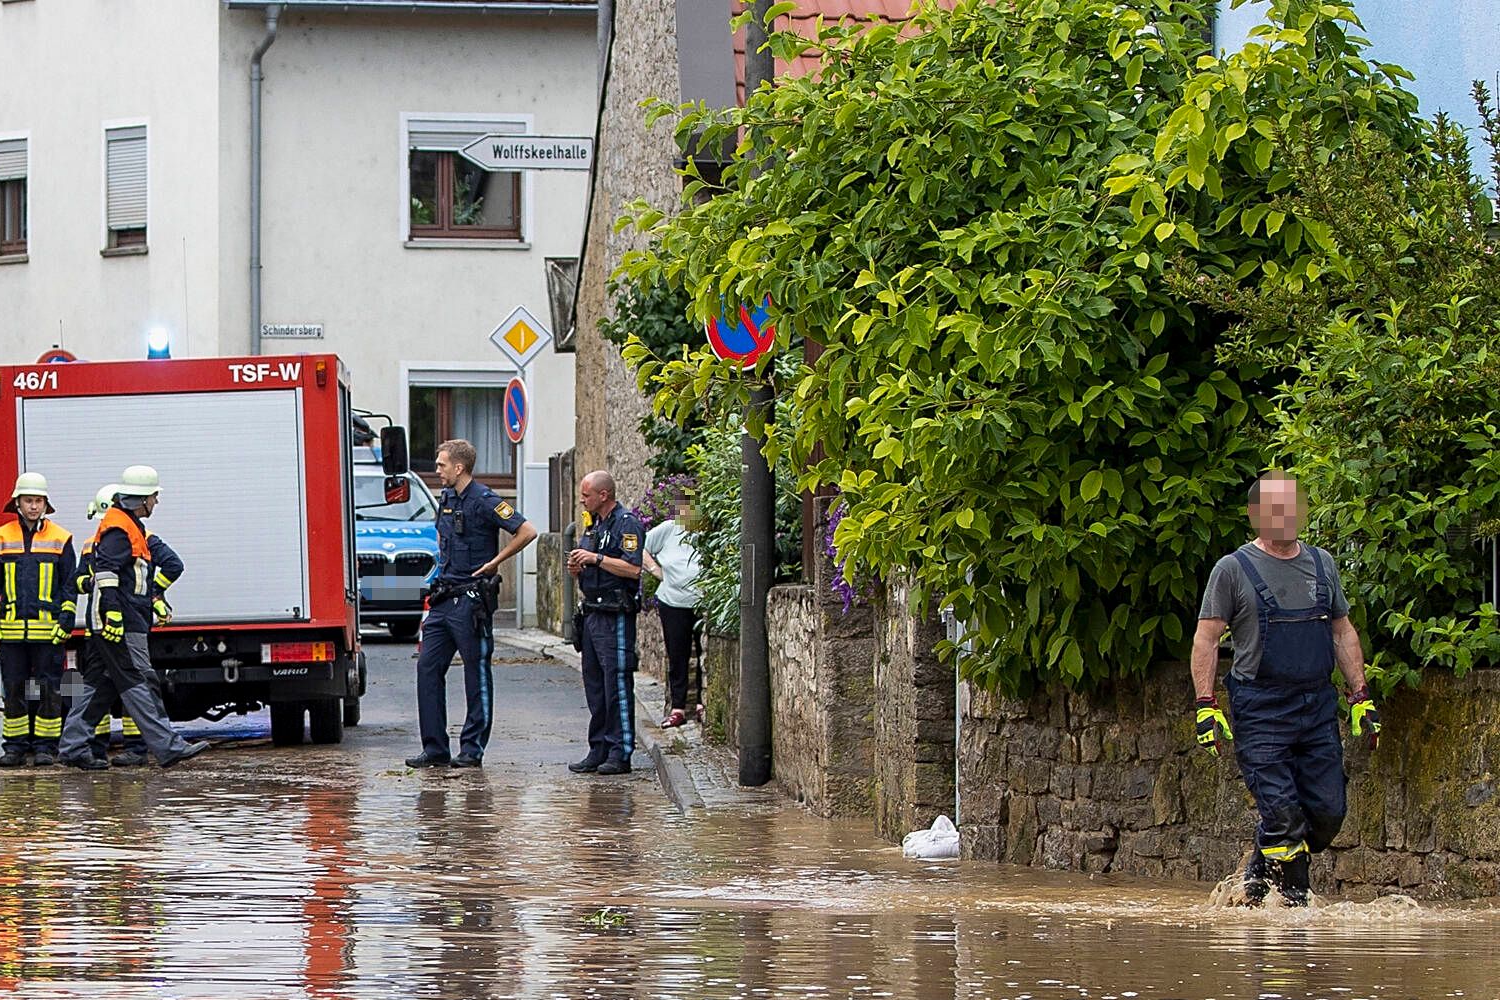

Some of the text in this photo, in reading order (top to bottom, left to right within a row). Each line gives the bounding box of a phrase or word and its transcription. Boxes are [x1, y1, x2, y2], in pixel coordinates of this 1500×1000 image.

[492, 144, 587, 159] Wolffskeelhalle
[262, 325, 322, 337] Schindersberg
[228, 362, 301, 382] TSF-W
[13, 371, 58, 390] 46/1
[356, 527, 422, 535] OLIZEI
